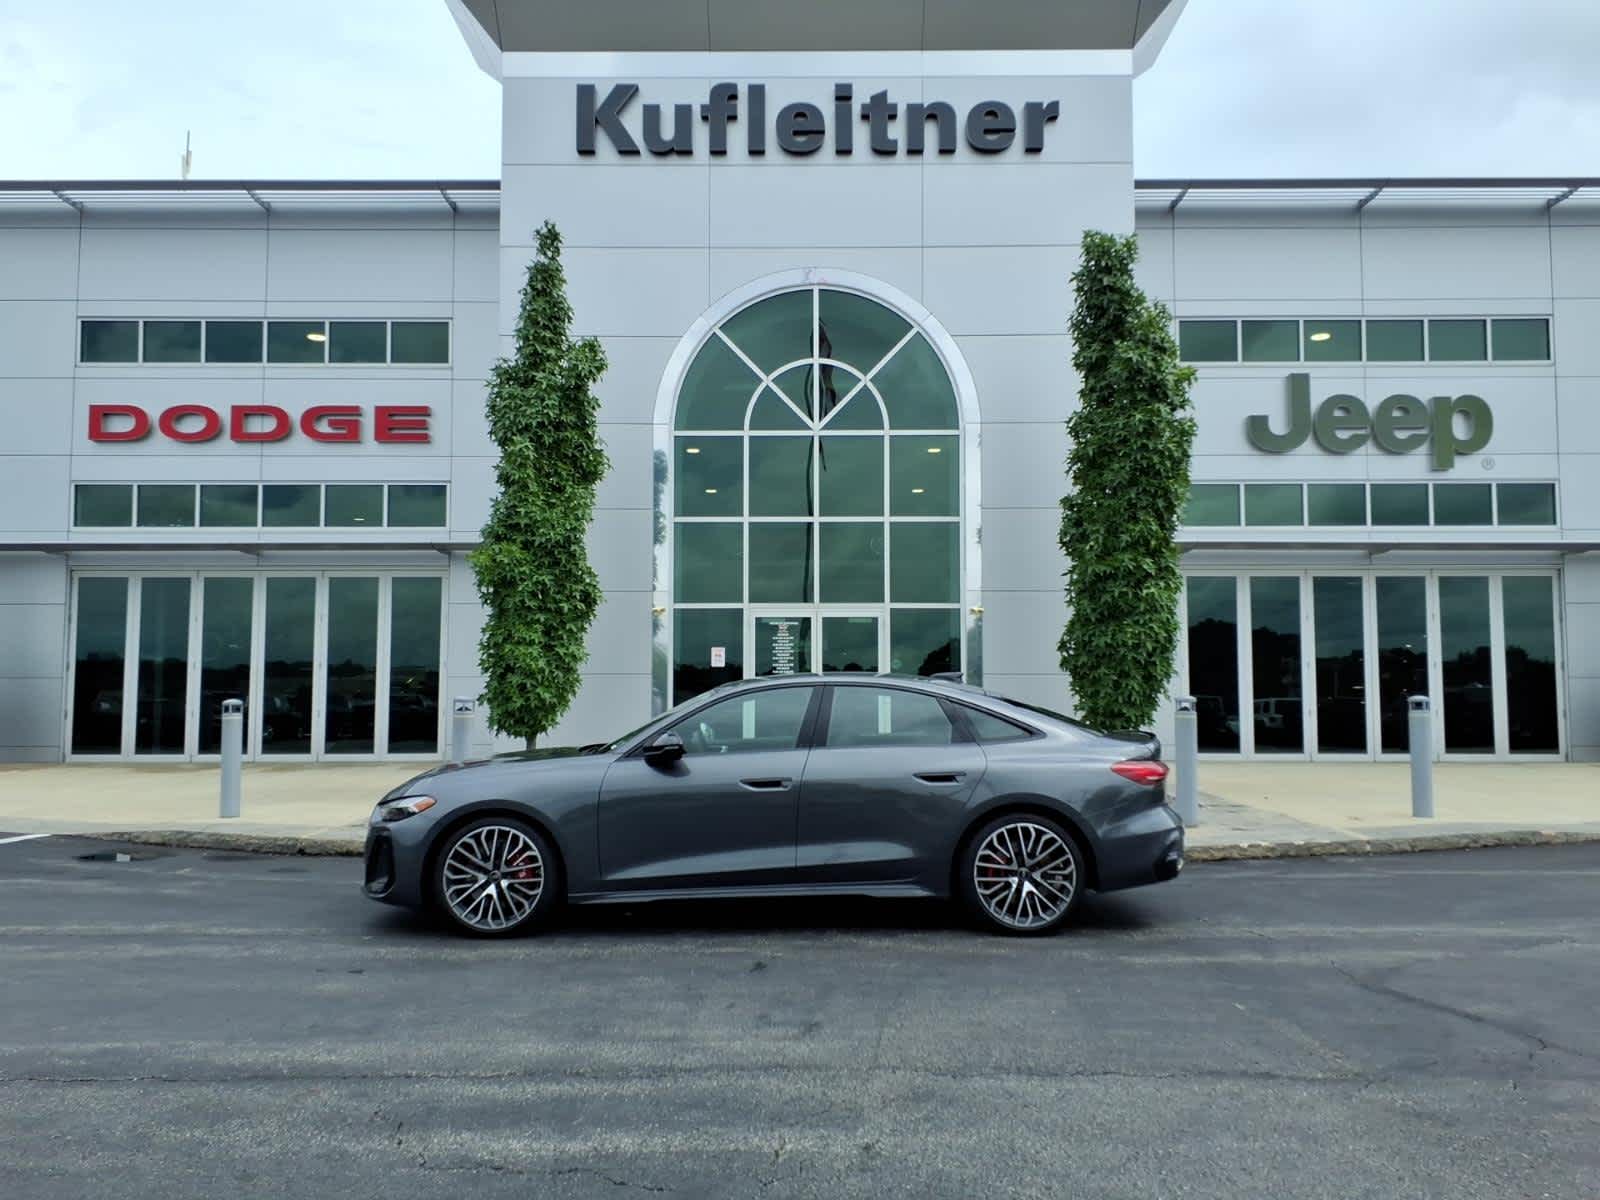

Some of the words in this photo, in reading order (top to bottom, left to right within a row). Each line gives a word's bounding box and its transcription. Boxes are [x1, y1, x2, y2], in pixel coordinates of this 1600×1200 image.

[576, 82, 1060, 156] Kufleitner
[88, 404, 431, 443] DODGE
[1246, 373, 1494, 471] Jeep
